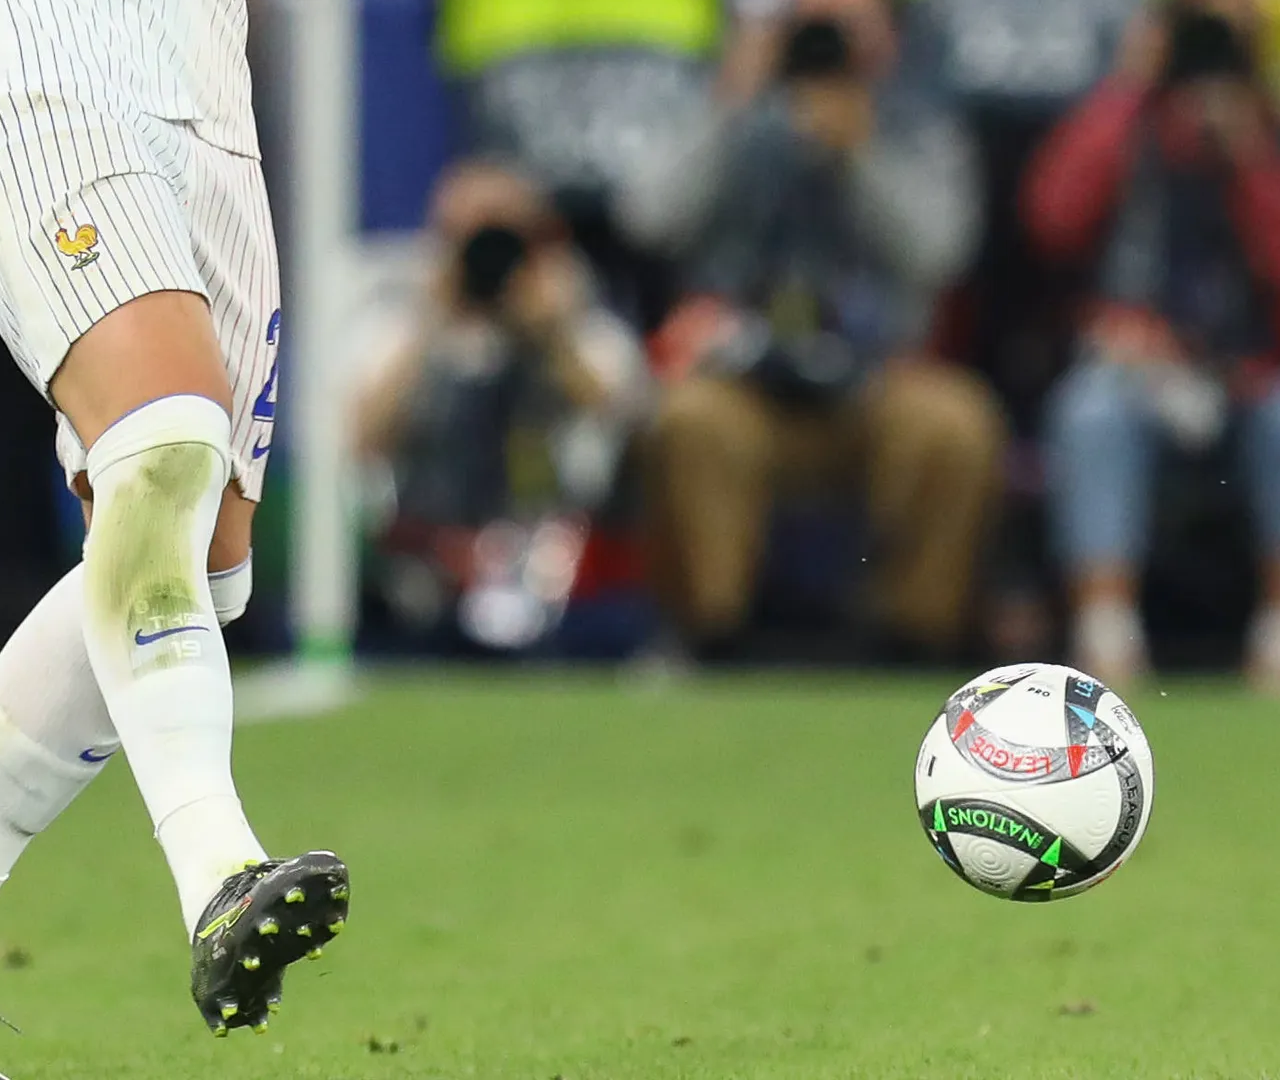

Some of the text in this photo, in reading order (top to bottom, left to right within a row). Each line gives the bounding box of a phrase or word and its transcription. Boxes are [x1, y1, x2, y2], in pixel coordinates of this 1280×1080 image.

[1027, 686, 1051, 697] PRO
[969, 735, 1052, 775] LEAGUE
[947, 806, 1040, 848] NATIONS
[1117, 772, 1138, 846] LEAGU
